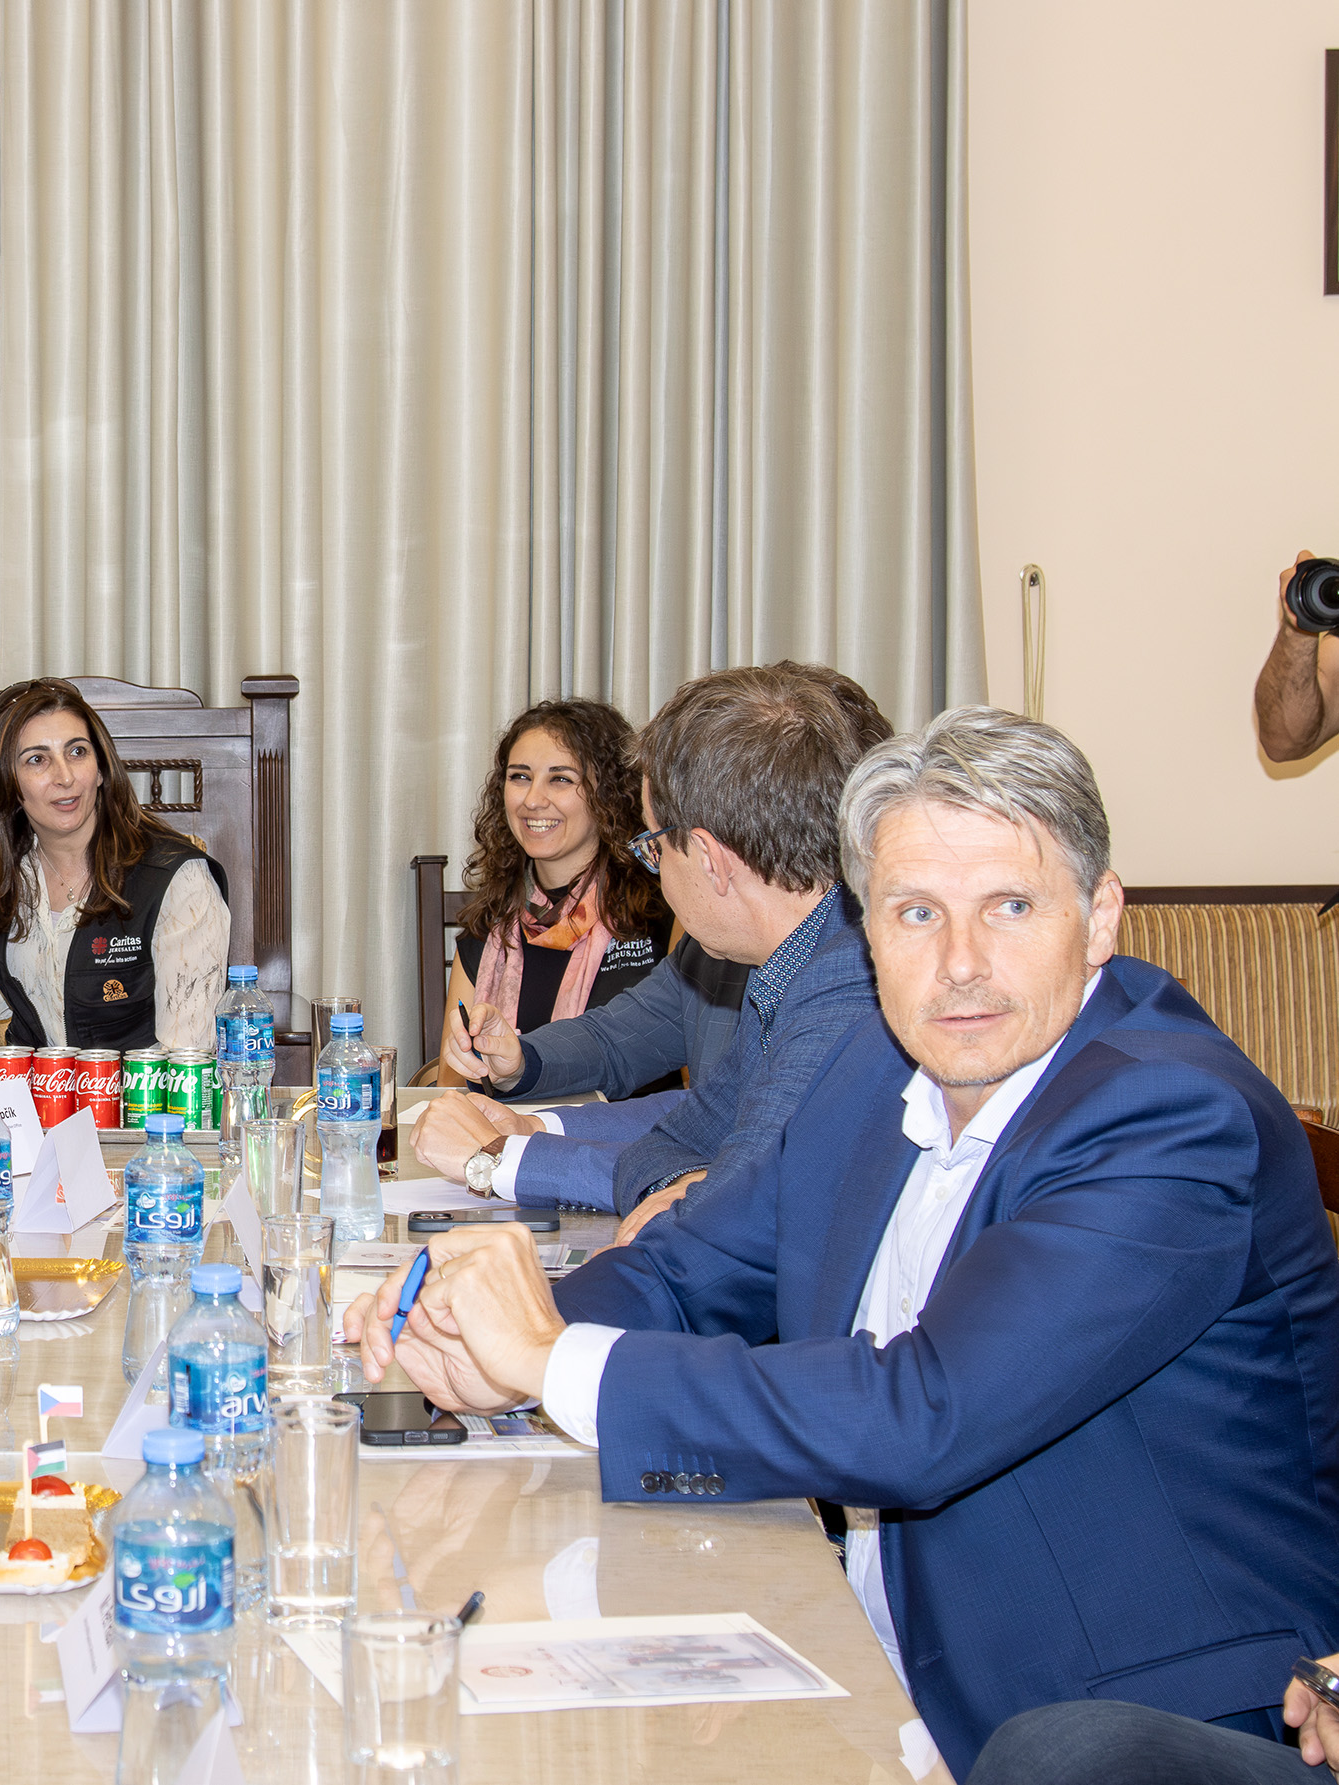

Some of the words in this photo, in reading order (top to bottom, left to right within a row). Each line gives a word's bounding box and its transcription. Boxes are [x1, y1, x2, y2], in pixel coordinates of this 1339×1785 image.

[108, 945, 142, 954] JERUSALEM
[110, 935, 142, 947] Caritas
[607, 946, 653, 963] JERUSALEM
[244, 1037, 274, 1051] arw
[33, 1068, 76, 1092] ca-Cola
[77, 1069, 121, 1096] Coca-Co
[123, 1066, 168, 1091] prite
[221, 1391, 268, 1418] arw
